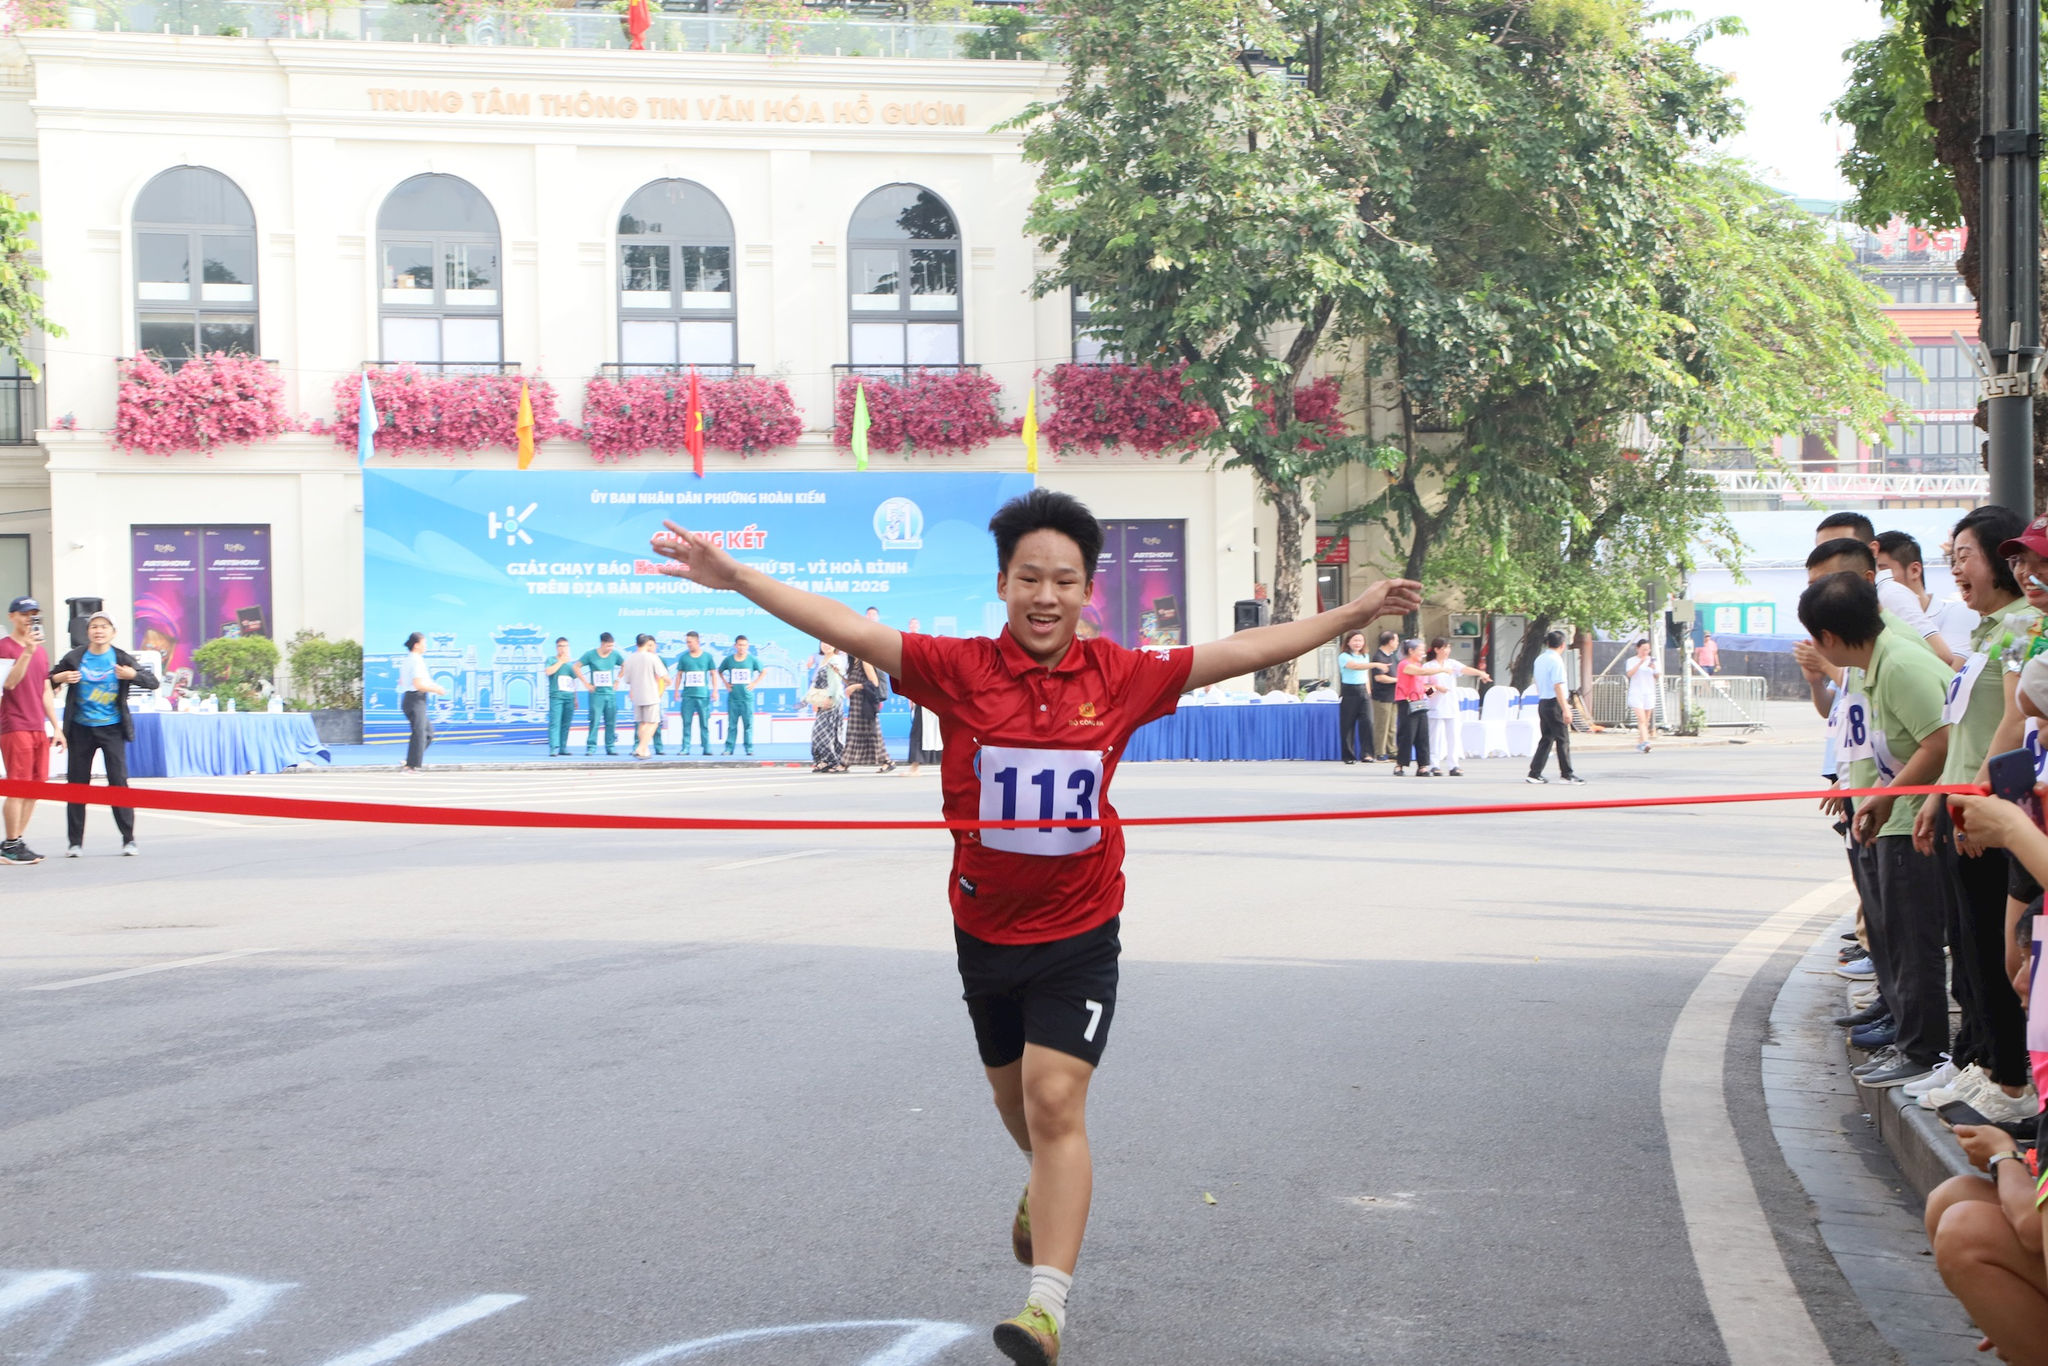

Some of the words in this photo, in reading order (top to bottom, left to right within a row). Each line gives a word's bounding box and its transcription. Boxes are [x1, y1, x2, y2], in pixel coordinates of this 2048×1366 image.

[367, 88, 463, 113] TRUNG
[471, 87, 530, 115] TÂM
[539, 90, 638, 119] THÔNG
[646, 97, 688, 120] TIN
[697, 95, 755, 122] VĂN
[764, 95, 825, 123] HÓA
[833, 93, 874, 124] HỒ
[882, 100, 965, 126] GƯƠM
[610, 493, 637, 504] BAN
[639, 491, 675, 504] NHÂN
[676, 491, 703, 504] DÂN
[704, 490, 757, 504] PHƯỜNG
[759, 491, 794, 504] HOÀN
[795, 489, 826, 504] KIẾM
[726, 524, 767, 549] KẾT
[507, 559, 548, 575] GIẢI
[550, 562, 595, 579] CHẠY
[597, 559, 631, 575] BÁO
[779, 562, 796, 574] 51
[808, 559, 828, 574] VÌ
[830, 559, 862, 574] HOÀ
[866, 559, 908, 574] BÌNH
[526, 578, 570, 594] TRÊN
[572, 581, 604, 598] ĐỊA
[608, 579, 642, 594] BÀN
[811, 577, 849, 592] NĂM
[851, 580, 890, 592] 2026
[994, 767, 1095, 833] 113
[1083, 1000, 1103, 1042] 7
